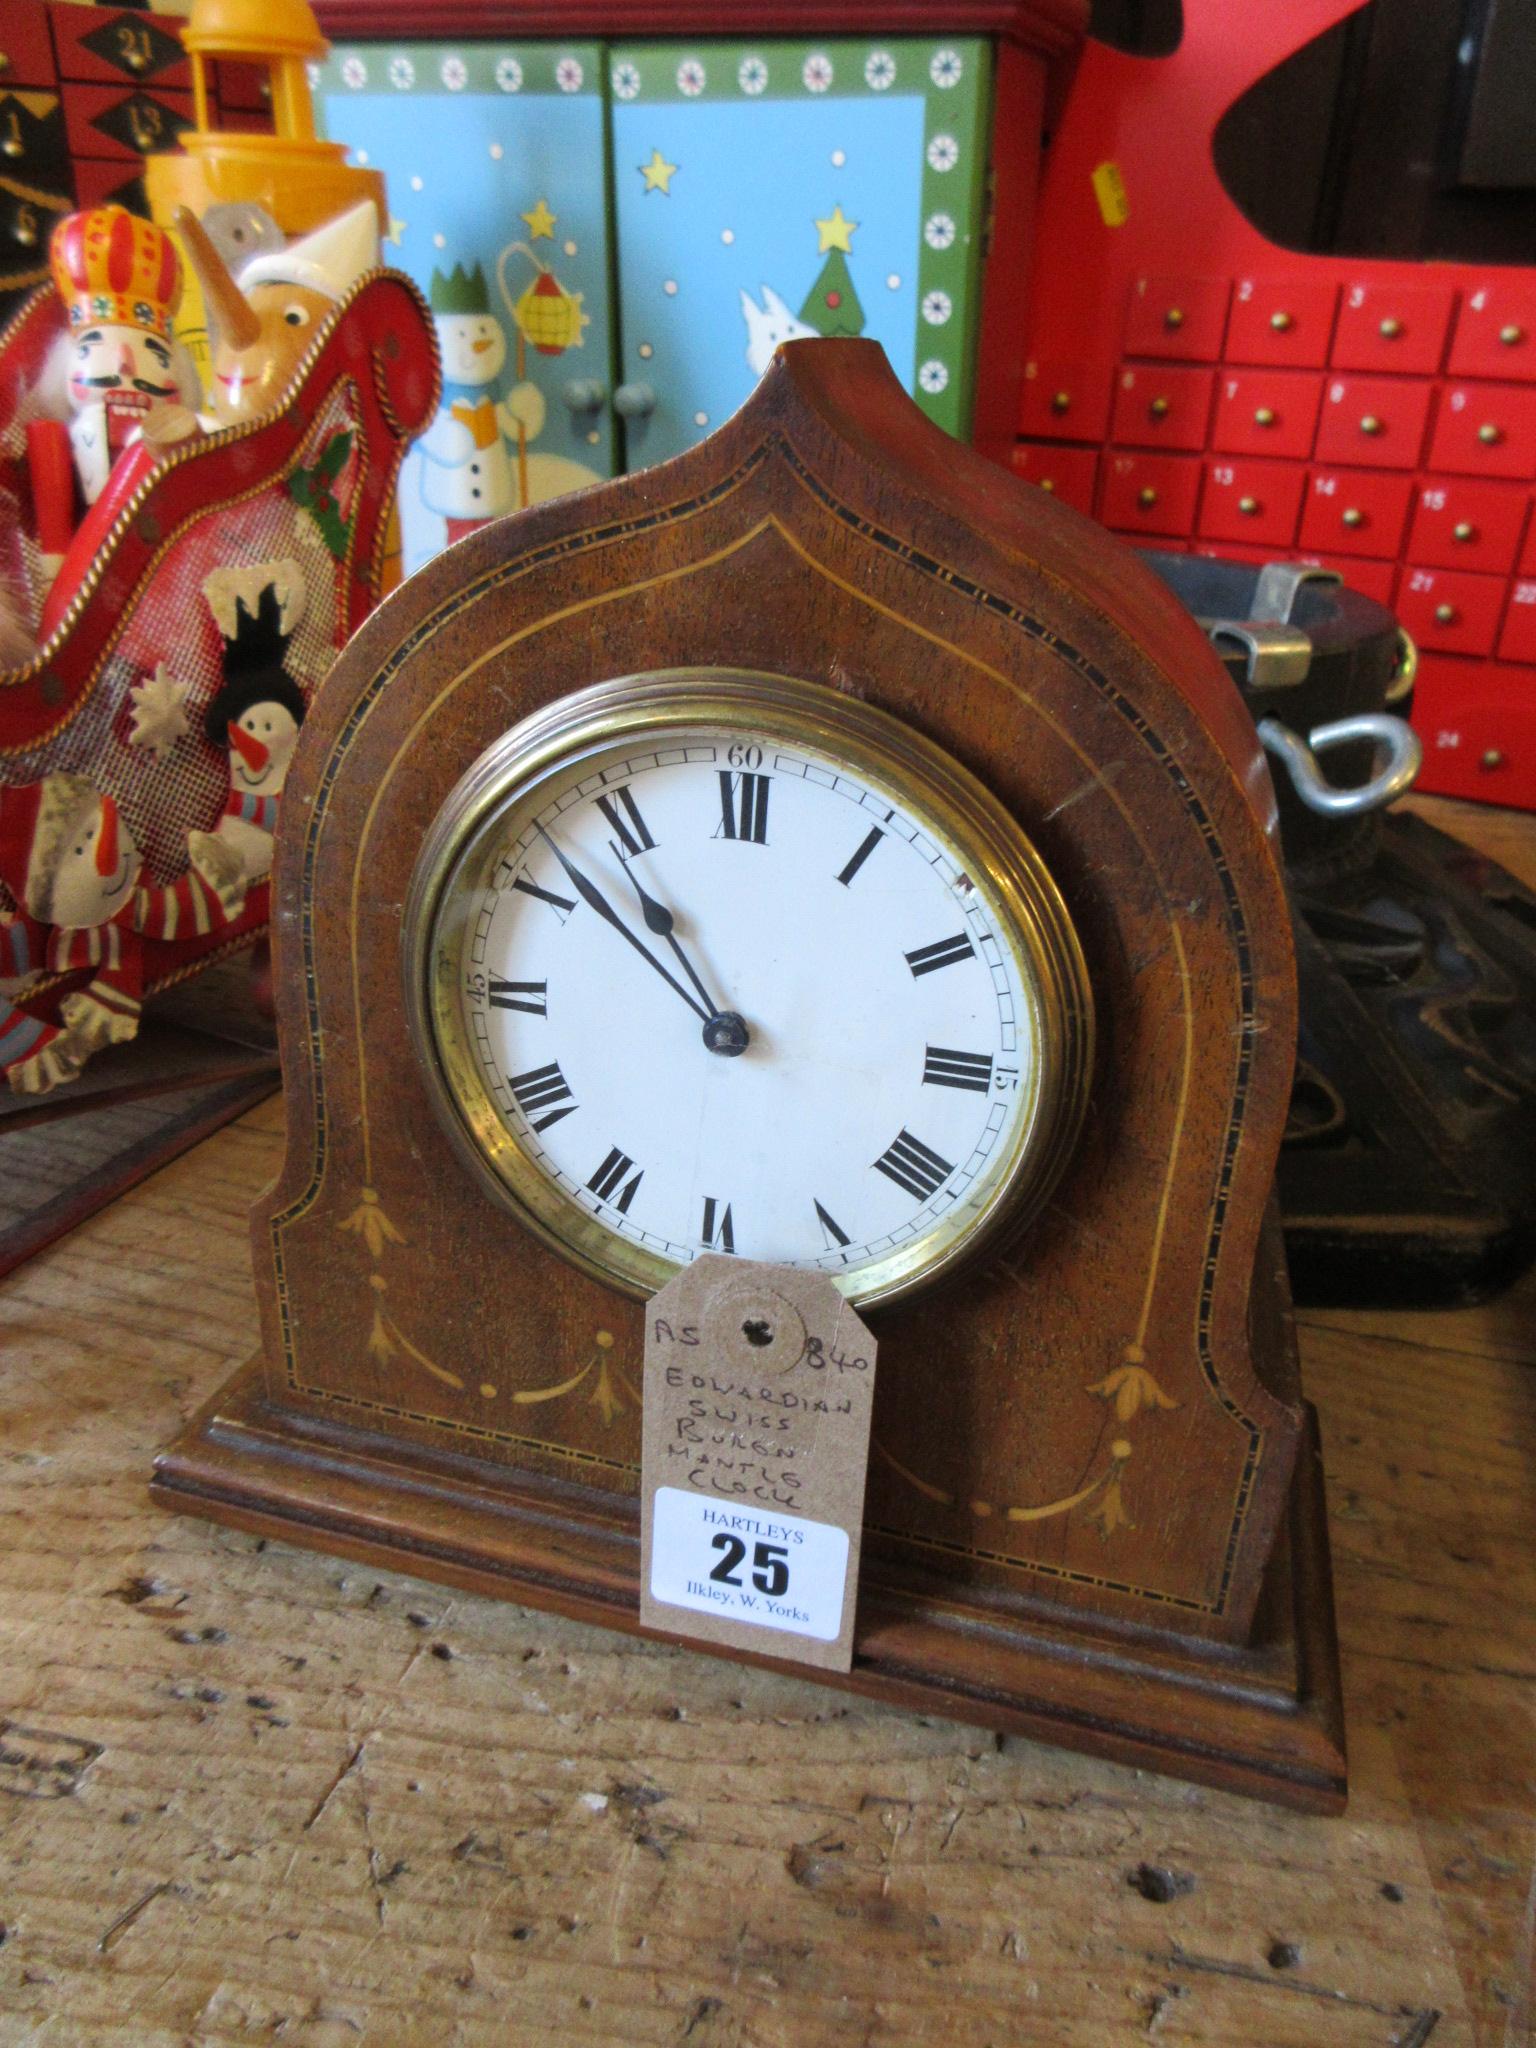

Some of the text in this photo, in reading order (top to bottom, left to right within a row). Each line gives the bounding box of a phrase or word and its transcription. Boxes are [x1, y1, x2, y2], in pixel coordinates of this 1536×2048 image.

[1239, 282, 1254, 301] 2
[1350, 287, 1366, 308] 3
[1470, 291, 1487, 311] 4
[1214, 468, 1234, 486] 13
[1315, 478, 1336, 496] 14
[1423, 490, 1446, 510] 15
[1410, 571, 1433, 593] 21
[727, 745, 763, 769] 60
[593, 785, 660, 858] XI
[710, 770, 774, 845] XII
[834, 822, 889, 888] I
[512, 866, 579, 925] X
[903, 931, 976, 979] II
[469, 973, 486, 1004] 45
[489, 969, 548, 1020] IX
[922, 1043, 994, 1097] III
[995, 1066, 1019, 1091] 15
[507, 1060, 579, 1133] VIII
[586, 1146, 646, 1217] VII
[700, 1196, 739, 1255] VI
[812, 1198, 856, 1250] V
[806, 1336, 868, 1374] 840
[666, 1367, 851, 1414] EDWARDIAN
[688, 1400, 790, 1430] SWISS
[703, 1509, 804, 1544] HARTLEYS
[709, 1532, 789, 1597] 25
[740, 1594, 760, 1610] W.
[766, 1600, 810, 1622] Yorks
